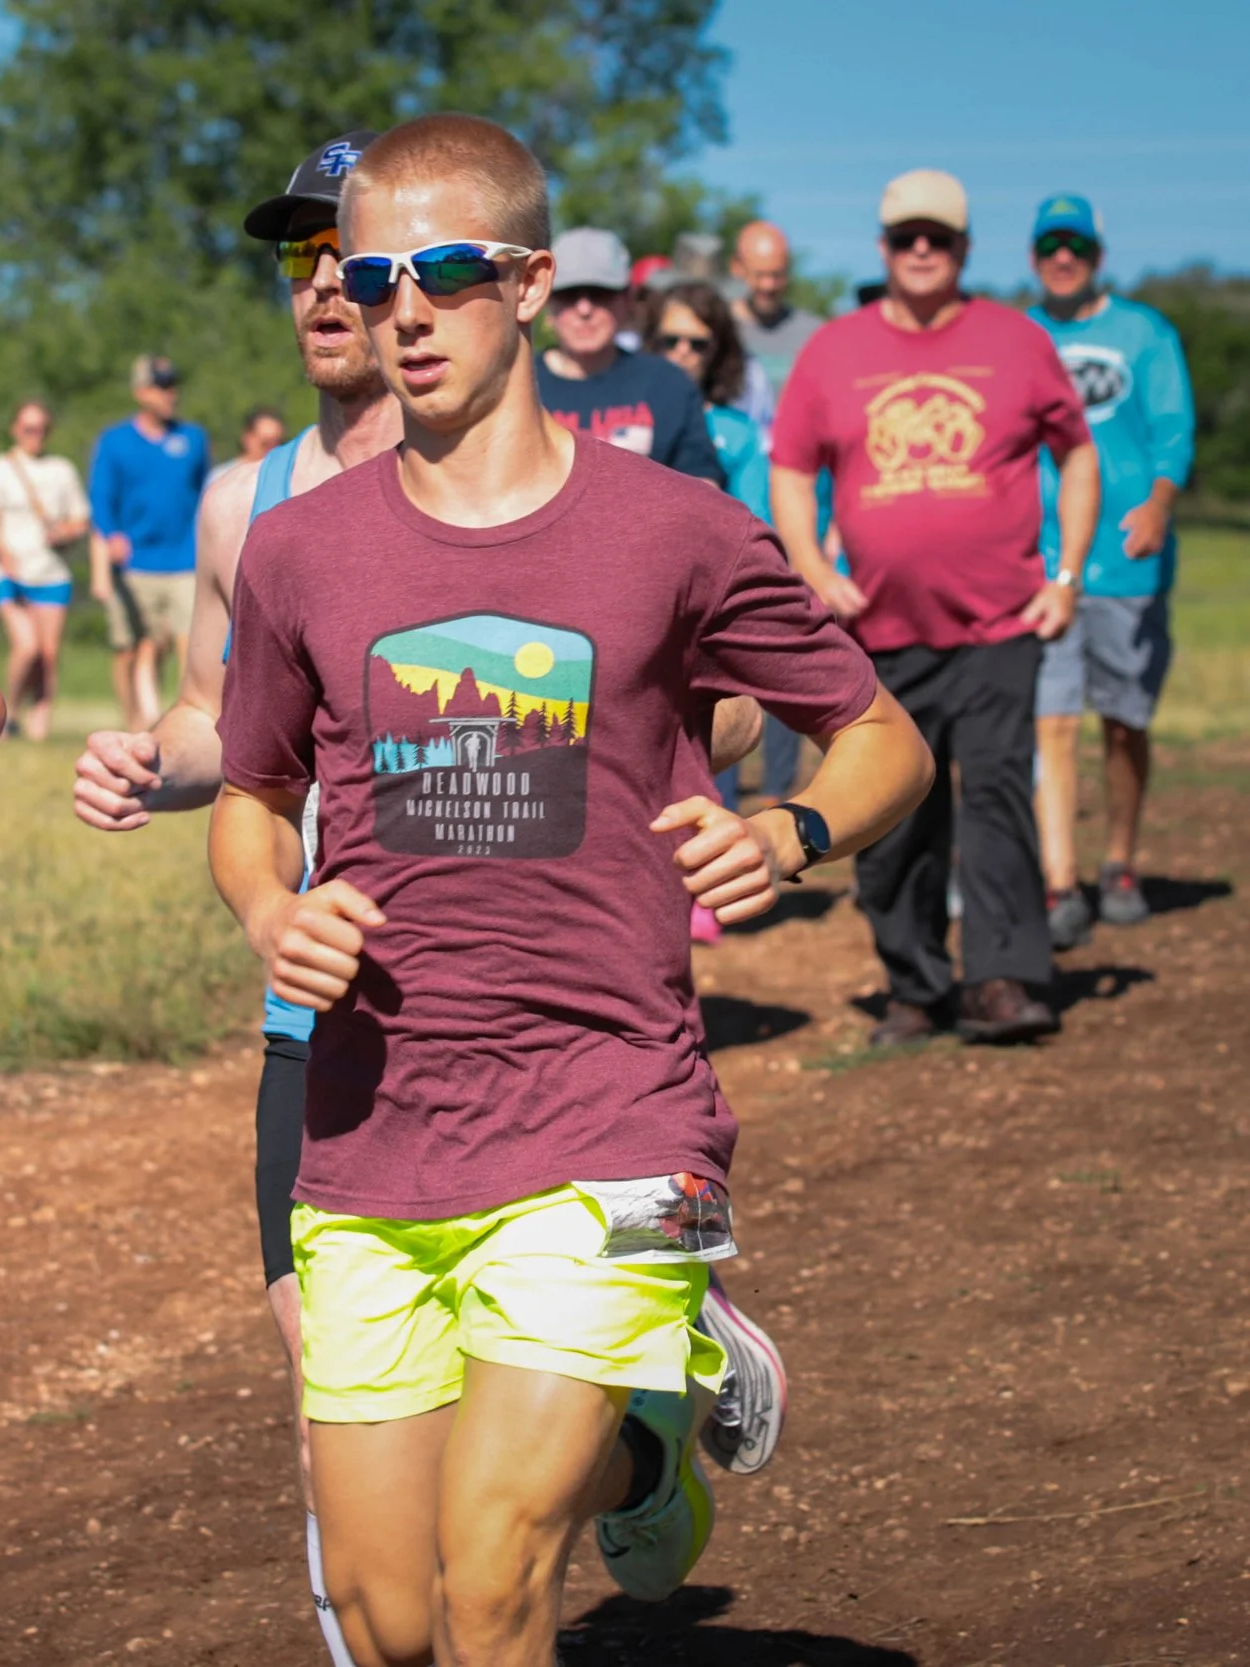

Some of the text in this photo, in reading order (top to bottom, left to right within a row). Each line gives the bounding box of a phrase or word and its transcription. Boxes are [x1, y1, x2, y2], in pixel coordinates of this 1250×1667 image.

[422, 771, 530, 796] DEADWOOD
[406, 799, 546, 820] MICKELSON TRAIL
[434, 823, 516, 843] MARATHON
